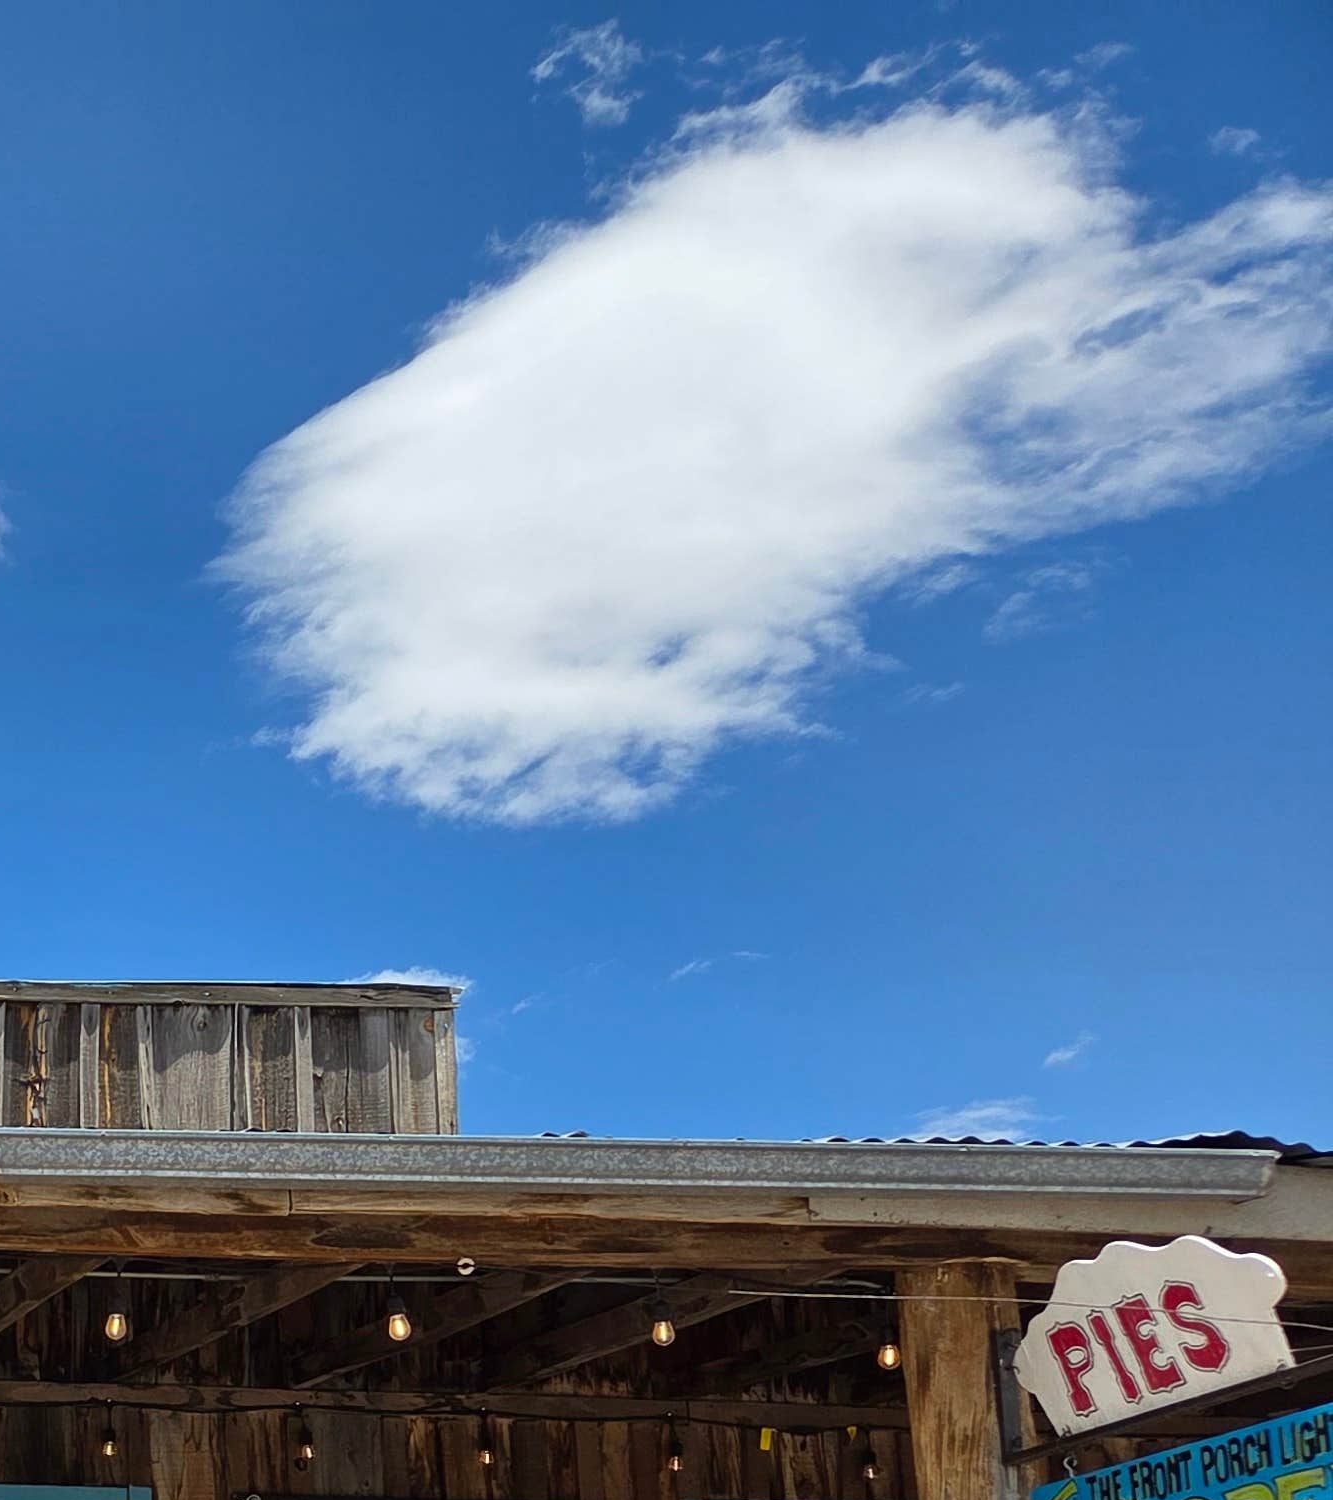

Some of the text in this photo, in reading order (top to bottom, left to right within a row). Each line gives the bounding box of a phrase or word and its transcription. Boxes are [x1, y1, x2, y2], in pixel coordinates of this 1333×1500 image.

[1045, 1280, 1230, 1417] PIES
[1201, 1428, 1273, 1487] PORCH
[1278, 1411, 1333, 1466] LIGH
